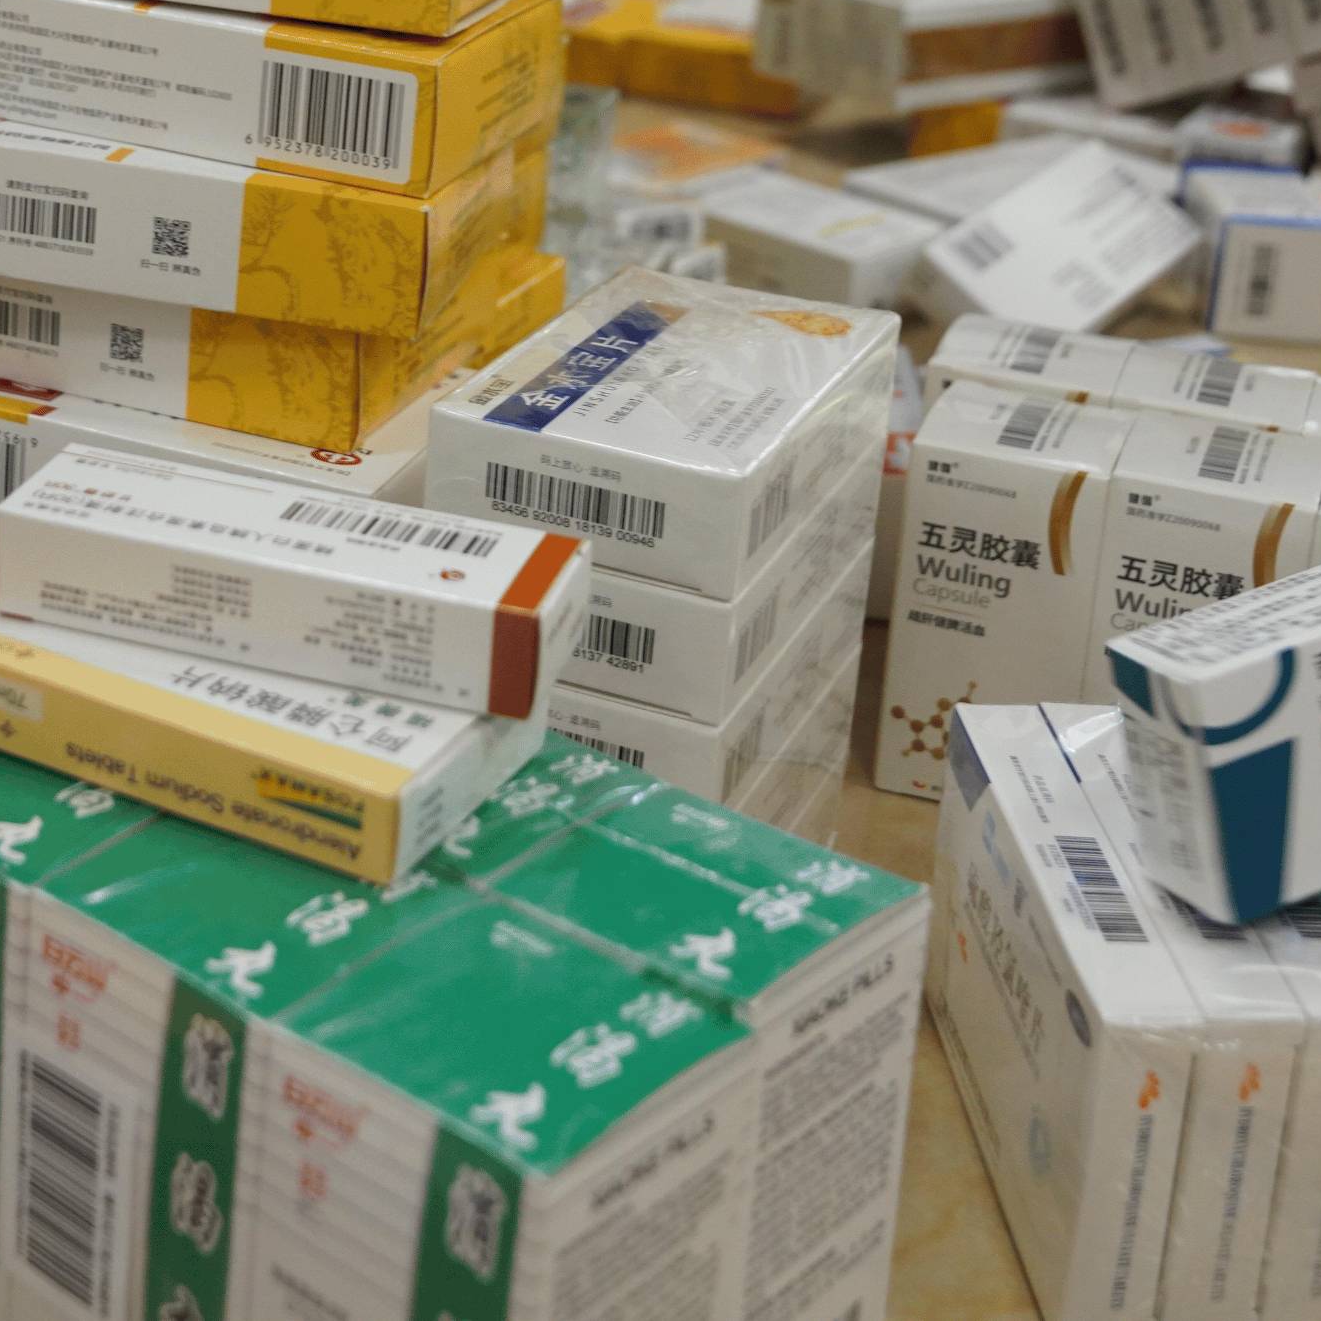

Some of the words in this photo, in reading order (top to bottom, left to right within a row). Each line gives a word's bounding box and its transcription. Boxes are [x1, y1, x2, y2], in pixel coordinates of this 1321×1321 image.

[244, 134, 254, 146] 6
[264, 136, 325, 159] 952378
[328, 146, 392, 170] 200039
[516, 333, 640, 412] 金水宝片
[30, 436, 39, 449] 6
[491, 498, 531, 521] 83456
[532, 506, 572, 530] 92008
[574, 517, 614, 540] 18139
[615, 526, 657, 551] 00946
[917, 521, 1041, 571] 五灵胶囊
[911, 577, 991, 610] Capsule
[915, 553, 1012, 599] Wuling
[1116, 554, 1246, 602] 五灵胶囊
[605, 654, 646, 675] 42891
[167, 664, 415, 759] 阿仑膦酸钠片
[63, 739, 138, 782] Tablets
[142, 763, 225, 816] Sodium
[228, 790, 364, 864] Alendronate
[670, 859, 871, 981] 消渴丸
[471, 991, 704, 1150] 消渴丸
